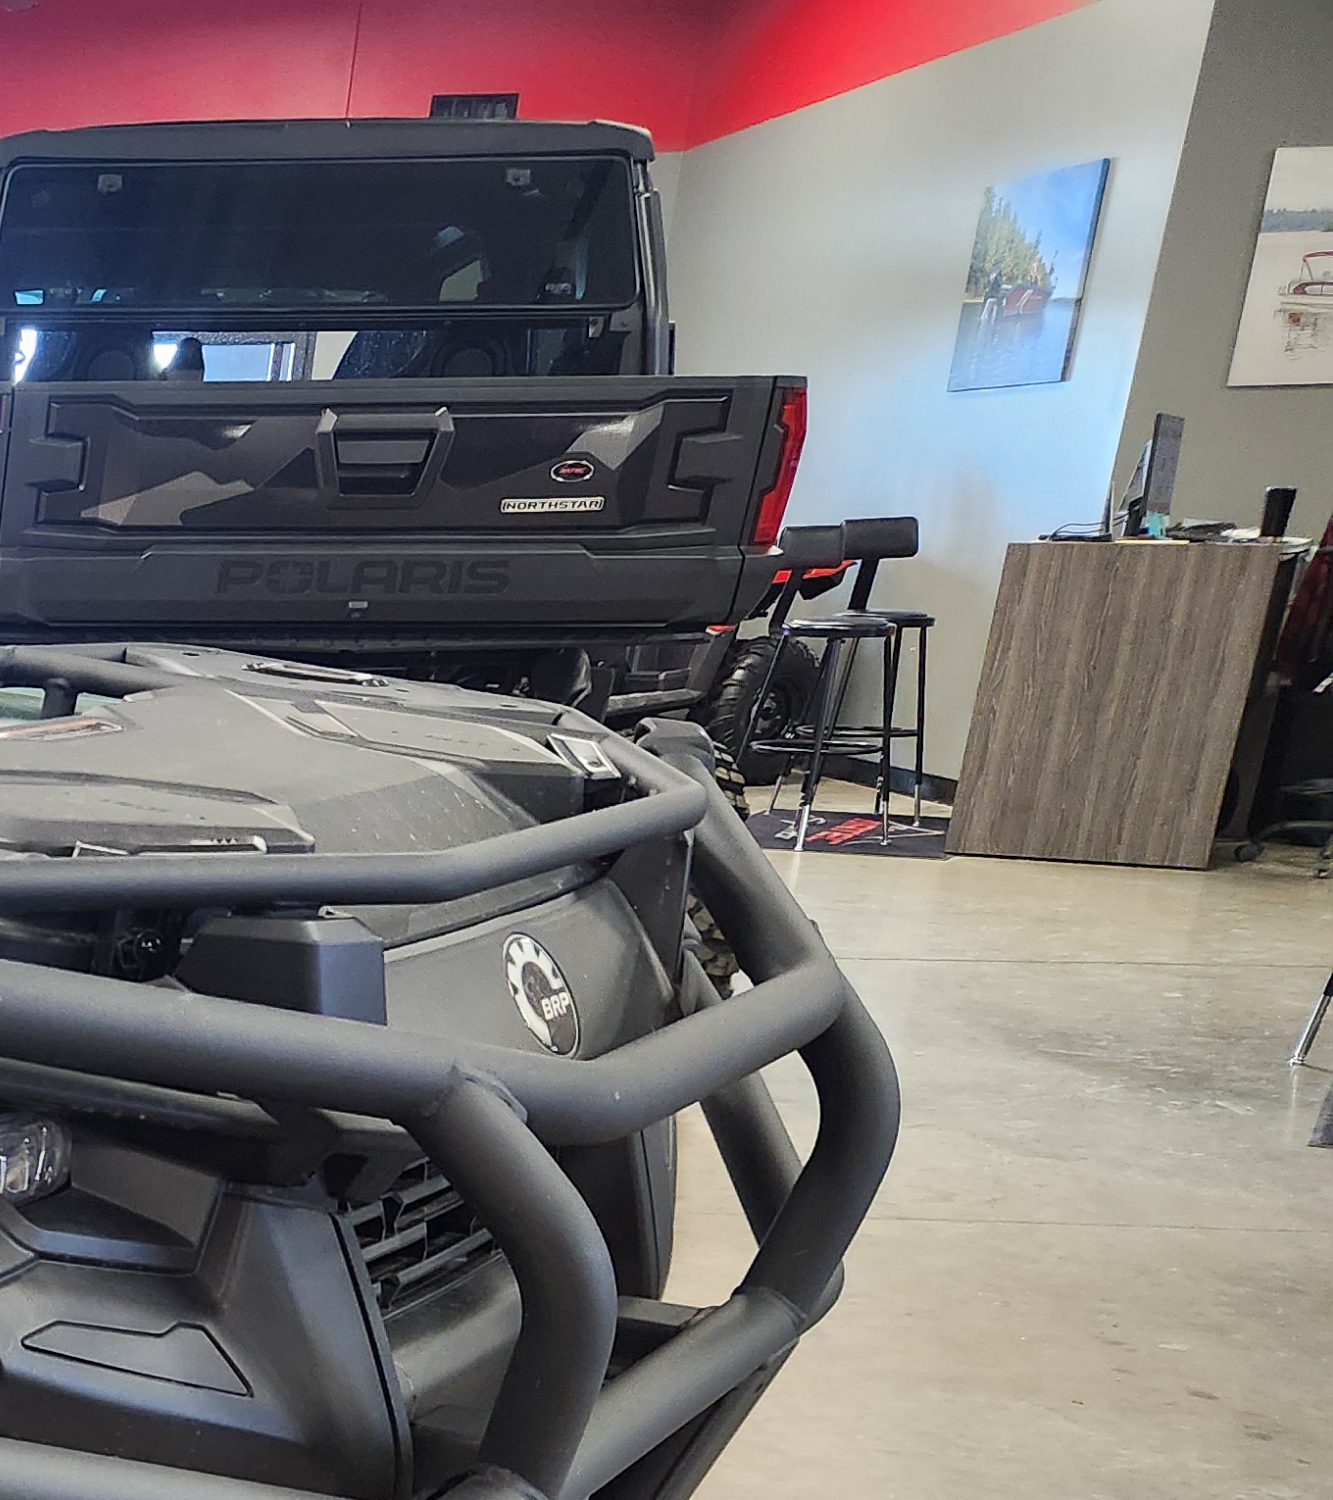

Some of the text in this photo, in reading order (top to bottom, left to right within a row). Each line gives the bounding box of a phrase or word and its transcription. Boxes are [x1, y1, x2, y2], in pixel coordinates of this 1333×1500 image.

[506, 500, 599, 511] NORTHSTAR
[216, 560, 510, 595] POLARIS
[541, 991, 571, 1020] BRP
